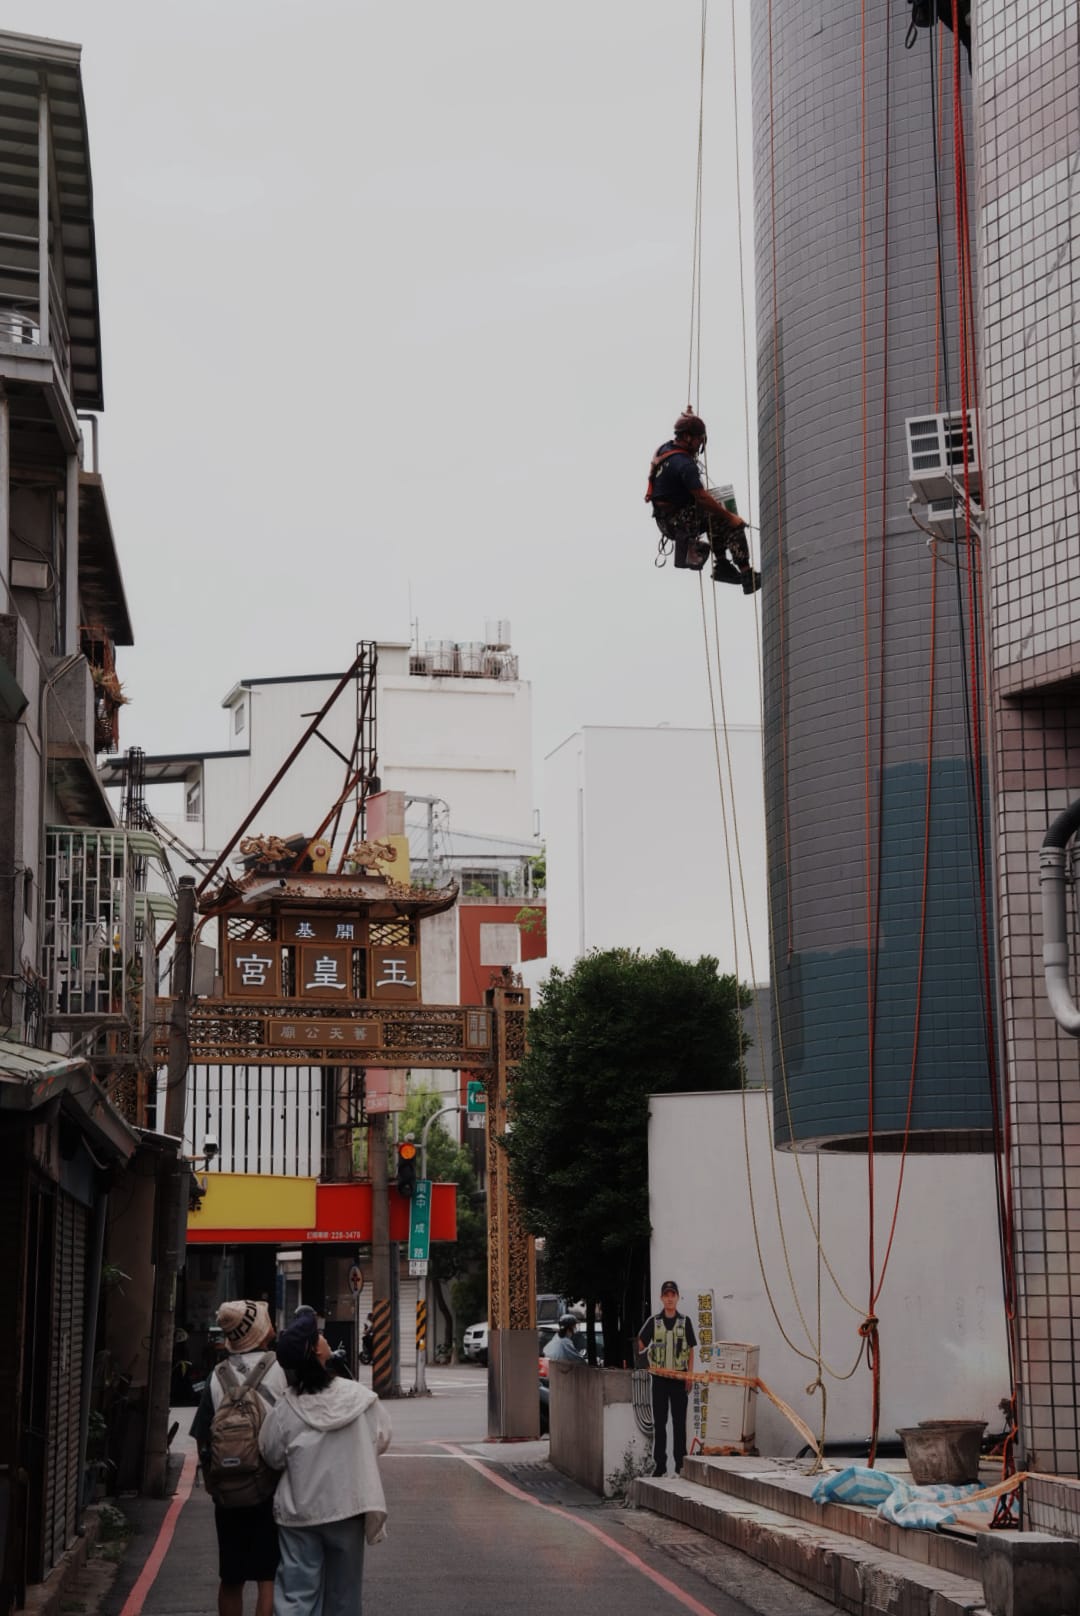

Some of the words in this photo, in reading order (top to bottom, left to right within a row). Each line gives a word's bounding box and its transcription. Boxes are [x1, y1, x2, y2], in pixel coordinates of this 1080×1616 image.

[296, 922, 354, 940] 開基
[236, 954, 416, 989] 玉皇宮
